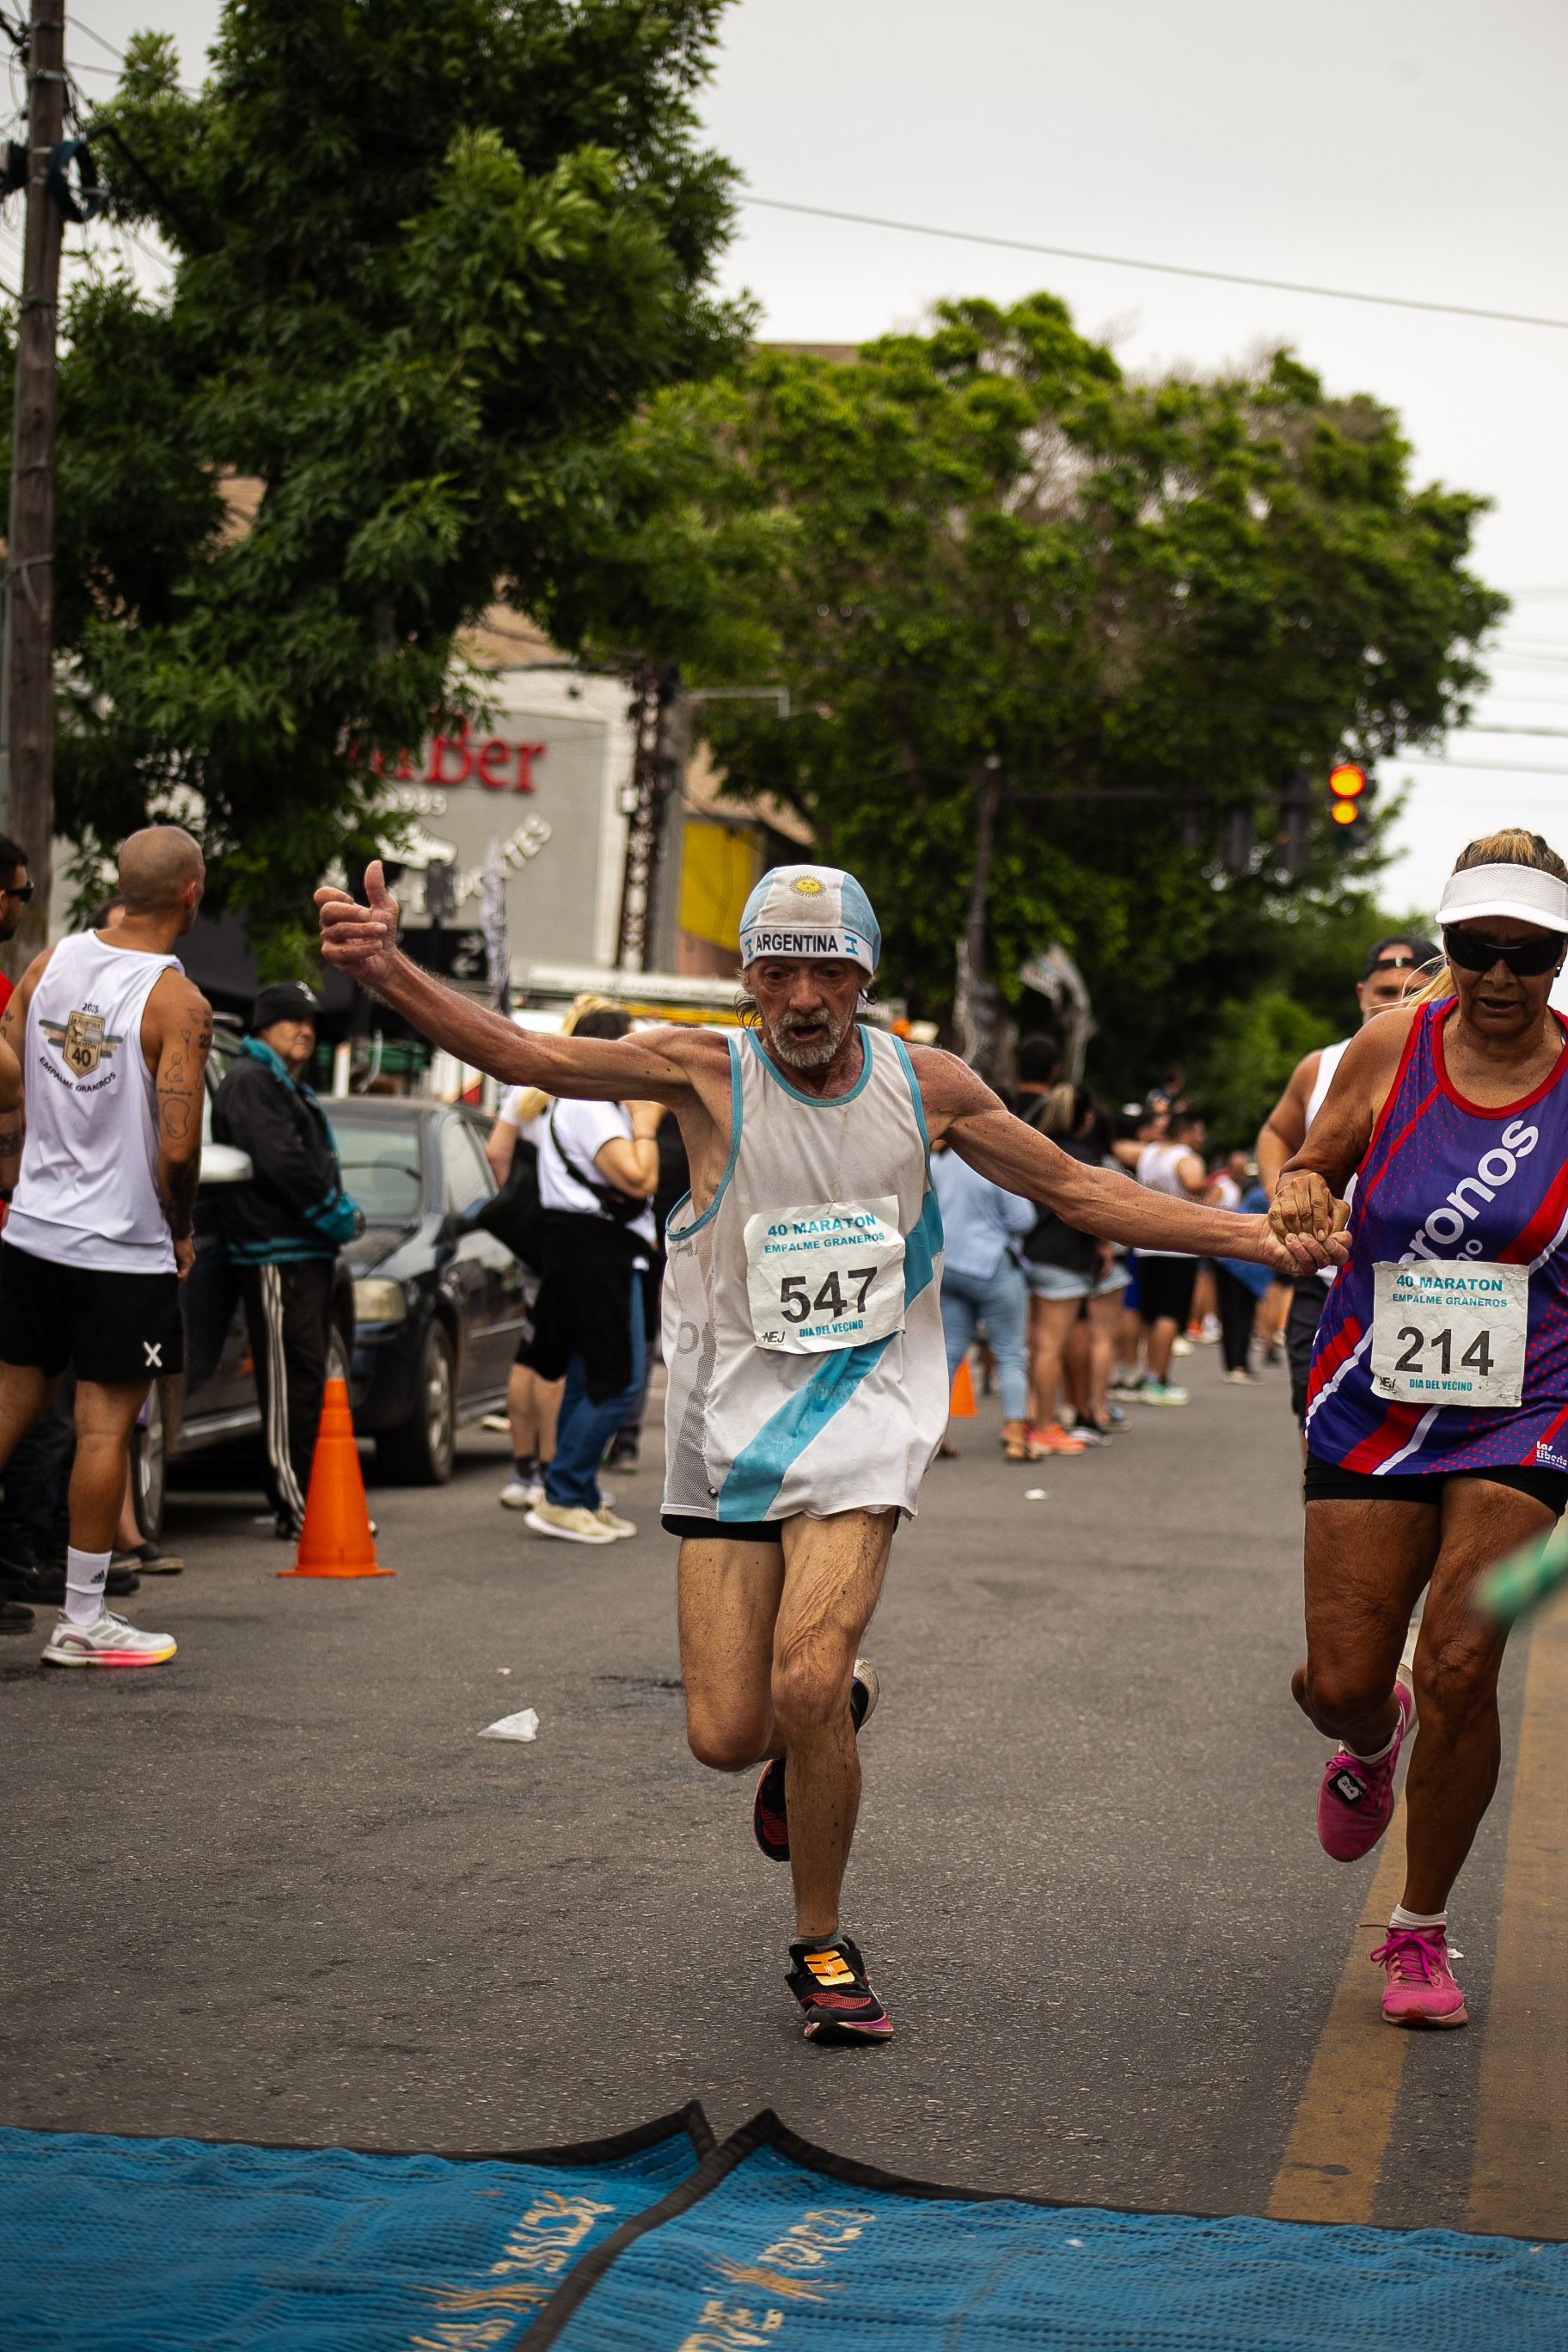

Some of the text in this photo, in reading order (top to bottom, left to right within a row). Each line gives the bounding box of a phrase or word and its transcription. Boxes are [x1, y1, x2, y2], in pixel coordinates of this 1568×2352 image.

[756, 934, 839, 952] ARGENTINA
[71, 1048, 91, 1066] 40
[39, 1057, 75, 1089] EMPALME
[1398, 1120, 1539, 1265] ronos
[768, 1214, 876, 1237] 40 MARATON
[764, 1233, 885, 1253] EMPALME GRANEROS
[1396, 1275, 1503, 1291] 40 MARATON
[780, 1266, 878, 1324] 547
[1393, 1293, 1508, 1308] EMPALME GRANEROS
[799, 1320, 864, 1338] DIA DEL VECINO
[1394, 1326, 1494, 1376] 214
[1409, 1379, 1473, 1392] DIA DEL VECINO
